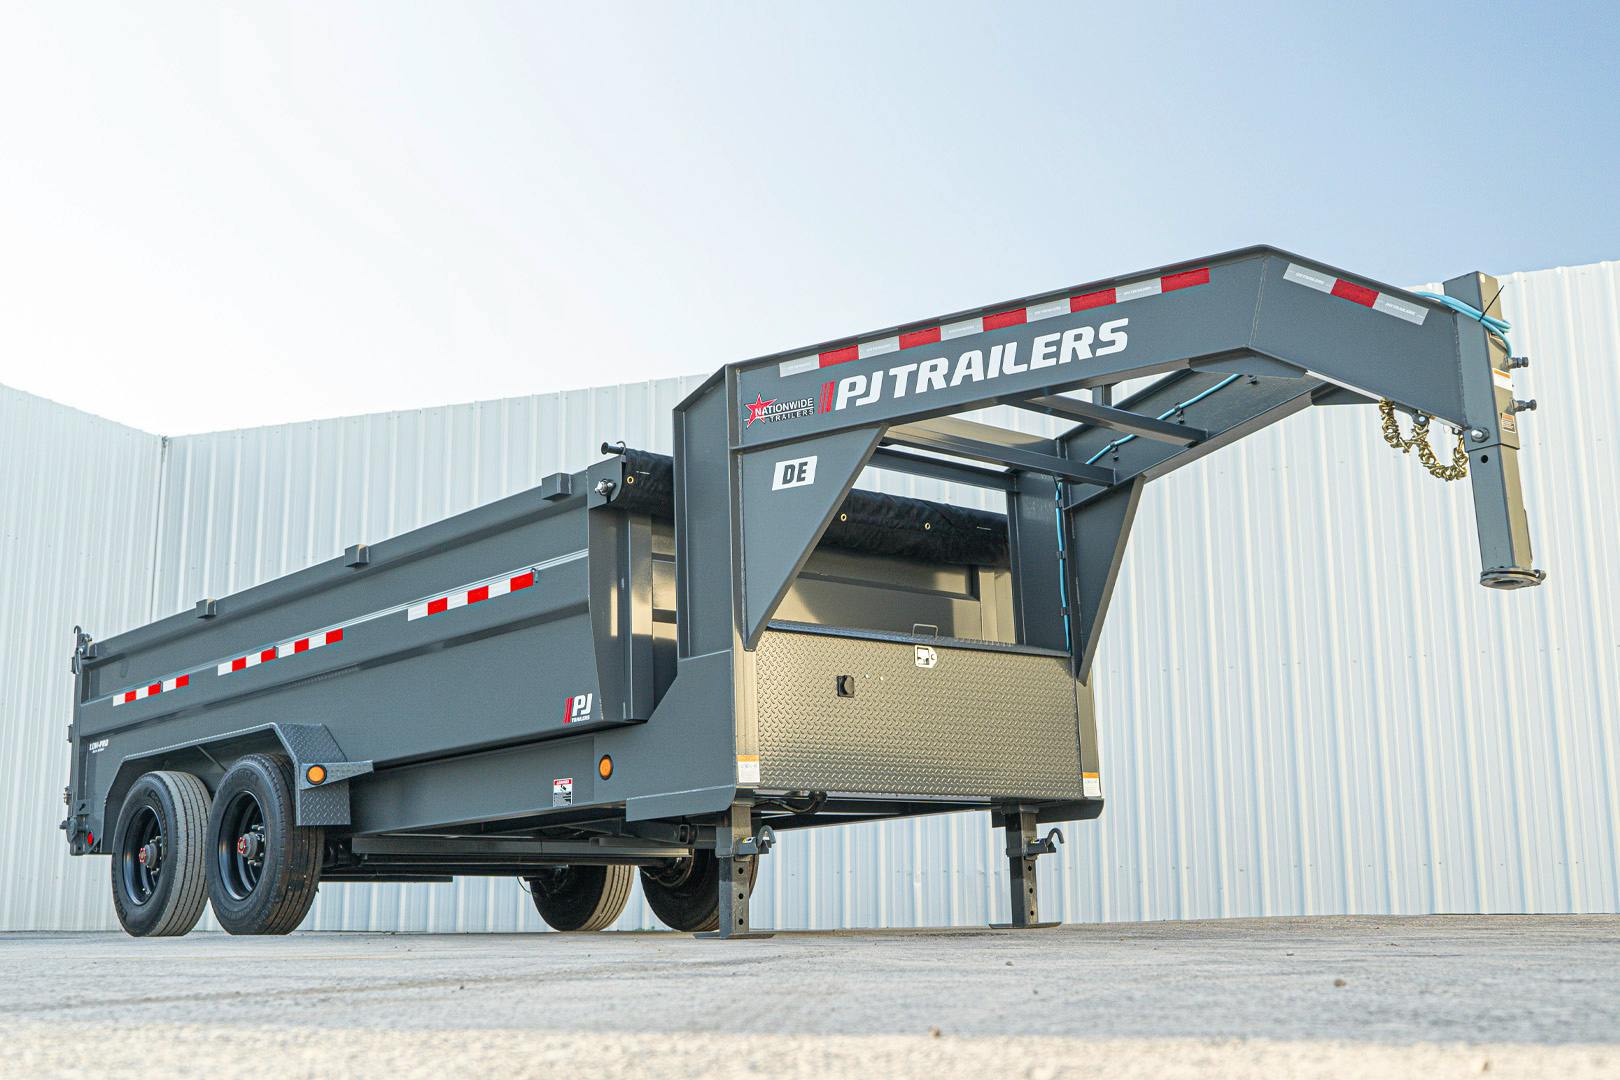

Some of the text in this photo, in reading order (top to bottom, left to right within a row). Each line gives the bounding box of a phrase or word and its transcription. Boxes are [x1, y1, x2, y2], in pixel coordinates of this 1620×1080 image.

[755, 397, 814, 416] NATIONWIDE
[770, 408, 814, 422] TRAILERS
[782, 461, 808, 485] DE
[572, 693, 593, 717] PJ
